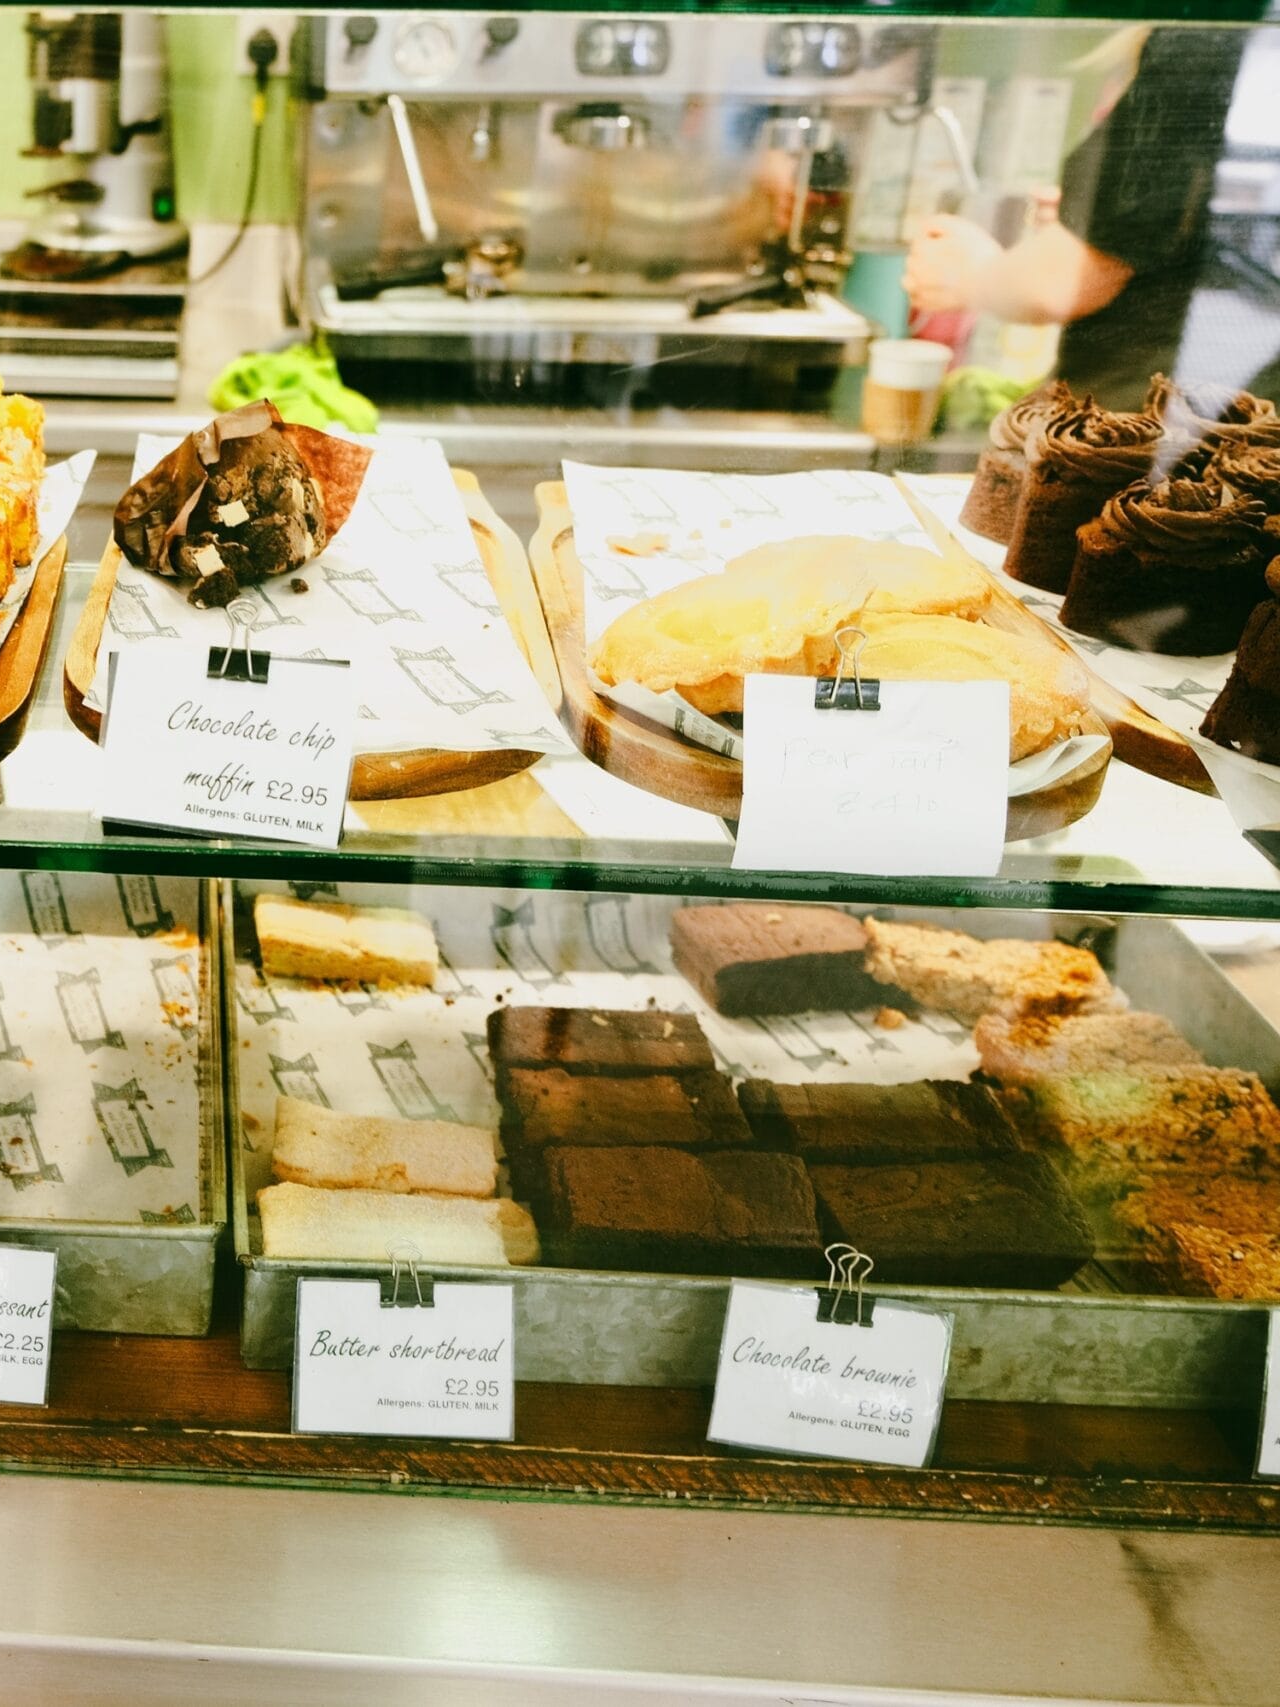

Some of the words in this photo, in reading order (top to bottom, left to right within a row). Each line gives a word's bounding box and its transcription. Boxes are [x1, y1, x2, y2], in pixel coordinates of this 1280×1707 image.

[167, 699, 279, 743] Chocolate
[288, 721, 337, 762] chip
[183, 761, 256, 802] muffin
[265, 779, 328, 807] £2.95
[184, 803, 240, 821] Allergens:
[242, 811, 293, 830] GLUTEN,
[295, 818, 325, 833] MILK
[308, 1329, 381, 1358] Butter
[388, 1334, 506, 1363] shortbread
[22, 1355, 44, 1367] EGG
[732, 1336, 832, 1376] Chocolate
[839, 1354, 919, 1389] brownie
[444, 1378, 500, 1397] £2.95
[376, 1397, 425, 1410] Allergens:
[427, 1399, 472, 1411] GLUTEN,
[474, 1401, 499, 1411] MILK
[856, 1399, 914, 1425] £2.95
[788, 1410, 838, 1428] Allergens:
[839, 1419, 885, 1435] GLUTEN,
[887, 1427, 911, 1439] EGG
